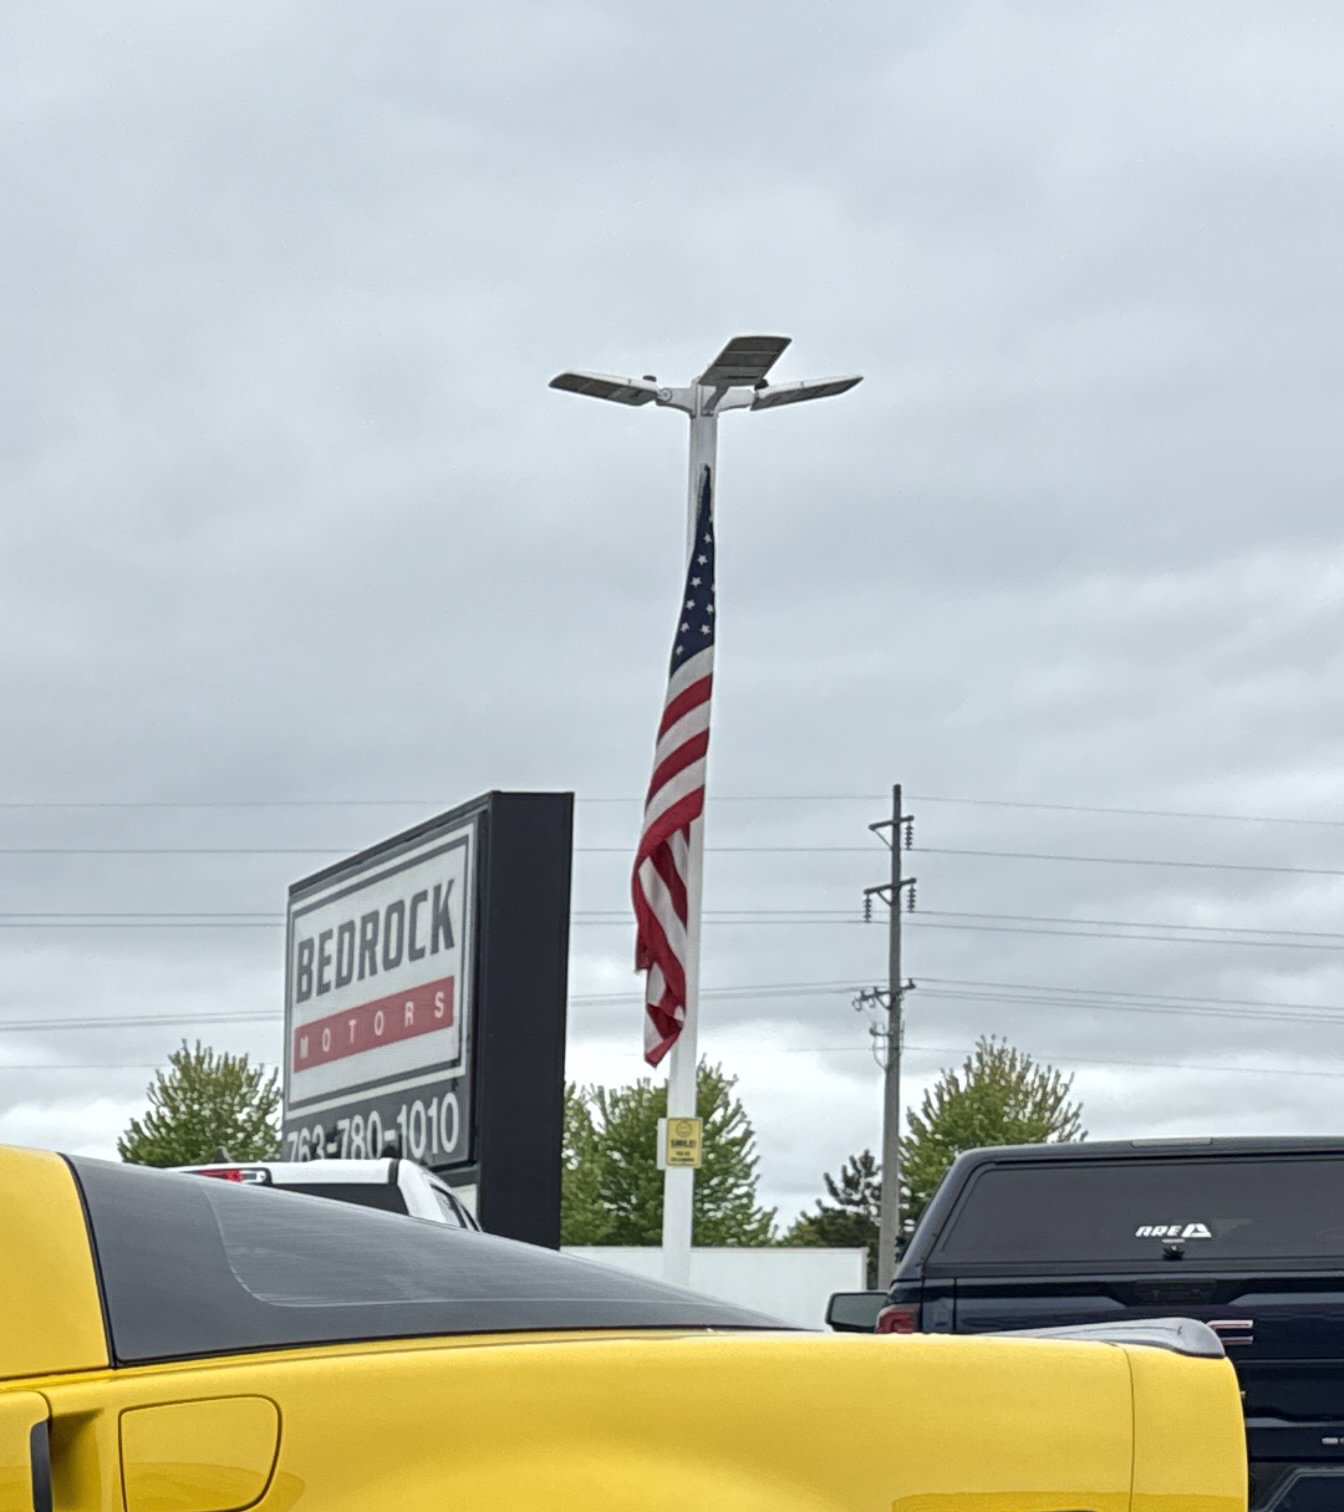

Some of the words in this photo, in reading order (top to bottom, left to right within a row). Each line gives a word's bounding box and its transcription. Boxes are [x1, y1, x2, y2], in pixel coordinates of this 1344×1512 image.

[296, 878, 455, 1004] BEDROCK
[299, 991, 445, 1060] MOTORS
[287, 1091, 459, 1162] 763-780-1010
